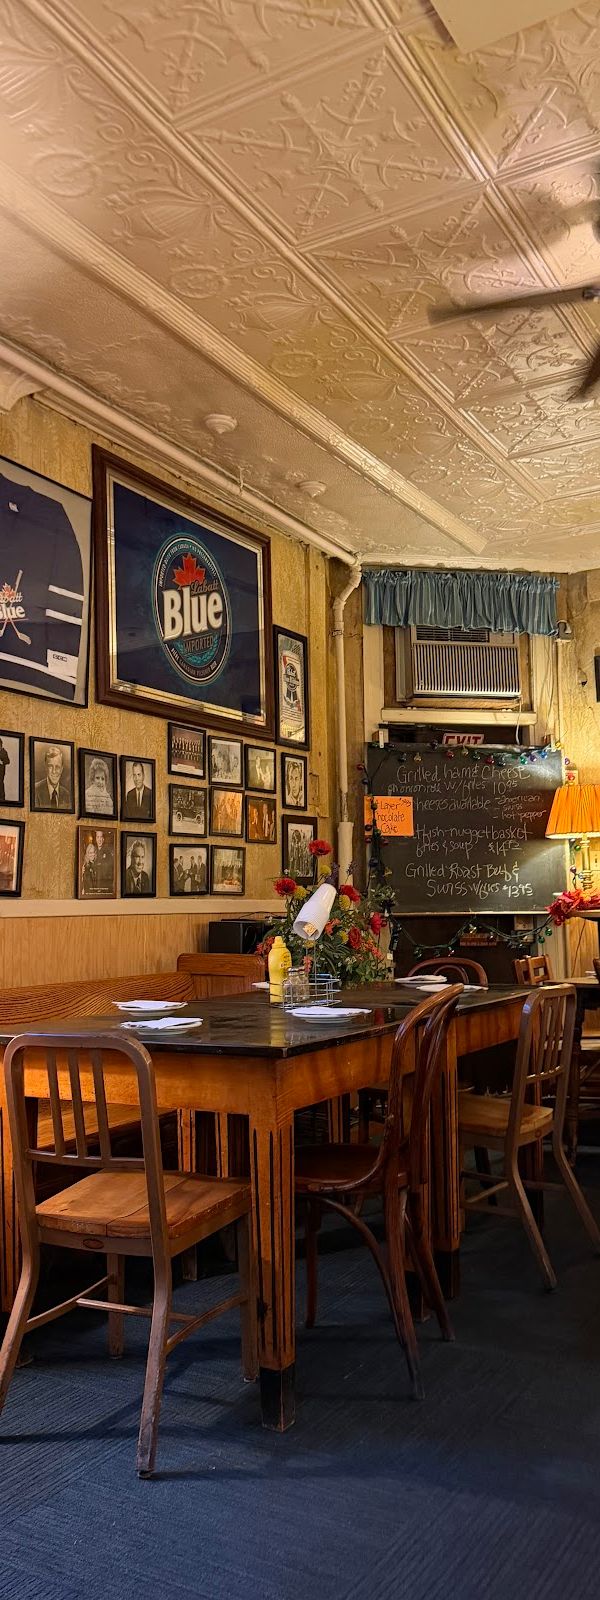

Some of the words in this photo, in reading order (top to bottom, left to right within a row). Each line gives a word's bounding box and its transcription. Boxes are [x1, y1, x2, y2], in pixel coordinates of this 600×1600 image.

[190, 580, 219, 594] Labatt
[162, 585, 224, 641] Blue
[183, 636, 214, 653] IMPORTED
[396, 764, 440, 783] Grilled
[405, 863, 446, 879] Grilled
[446, 862, 482, 880] Roast
[426, 879, 468, 898] Swiss
